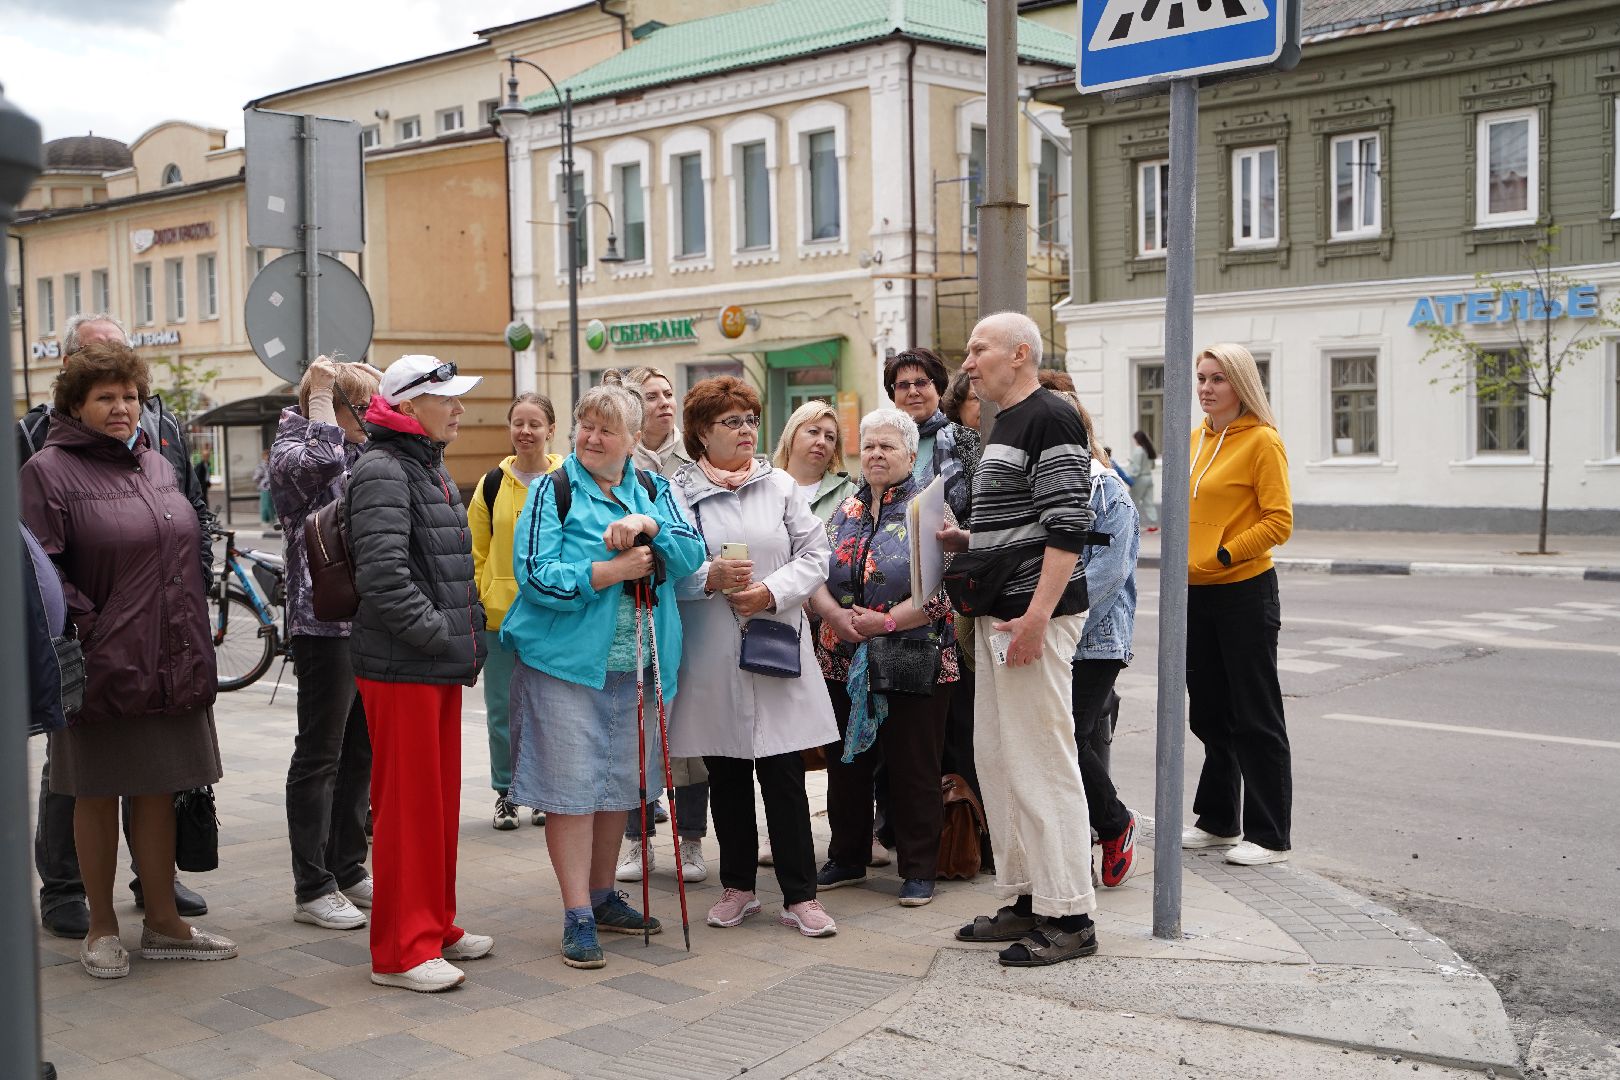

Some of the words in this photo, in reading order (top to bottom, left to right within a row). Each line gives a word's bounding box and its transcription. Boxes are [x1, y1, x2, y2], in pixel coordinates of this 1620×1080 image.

[1408, 284, 1599, 327] АТЕЛЬЕ
[726, 311, 742, 325] 24
[609, 317, 697, 345] СБЕРБАНК
[32, 341, 60, 359] DNS
